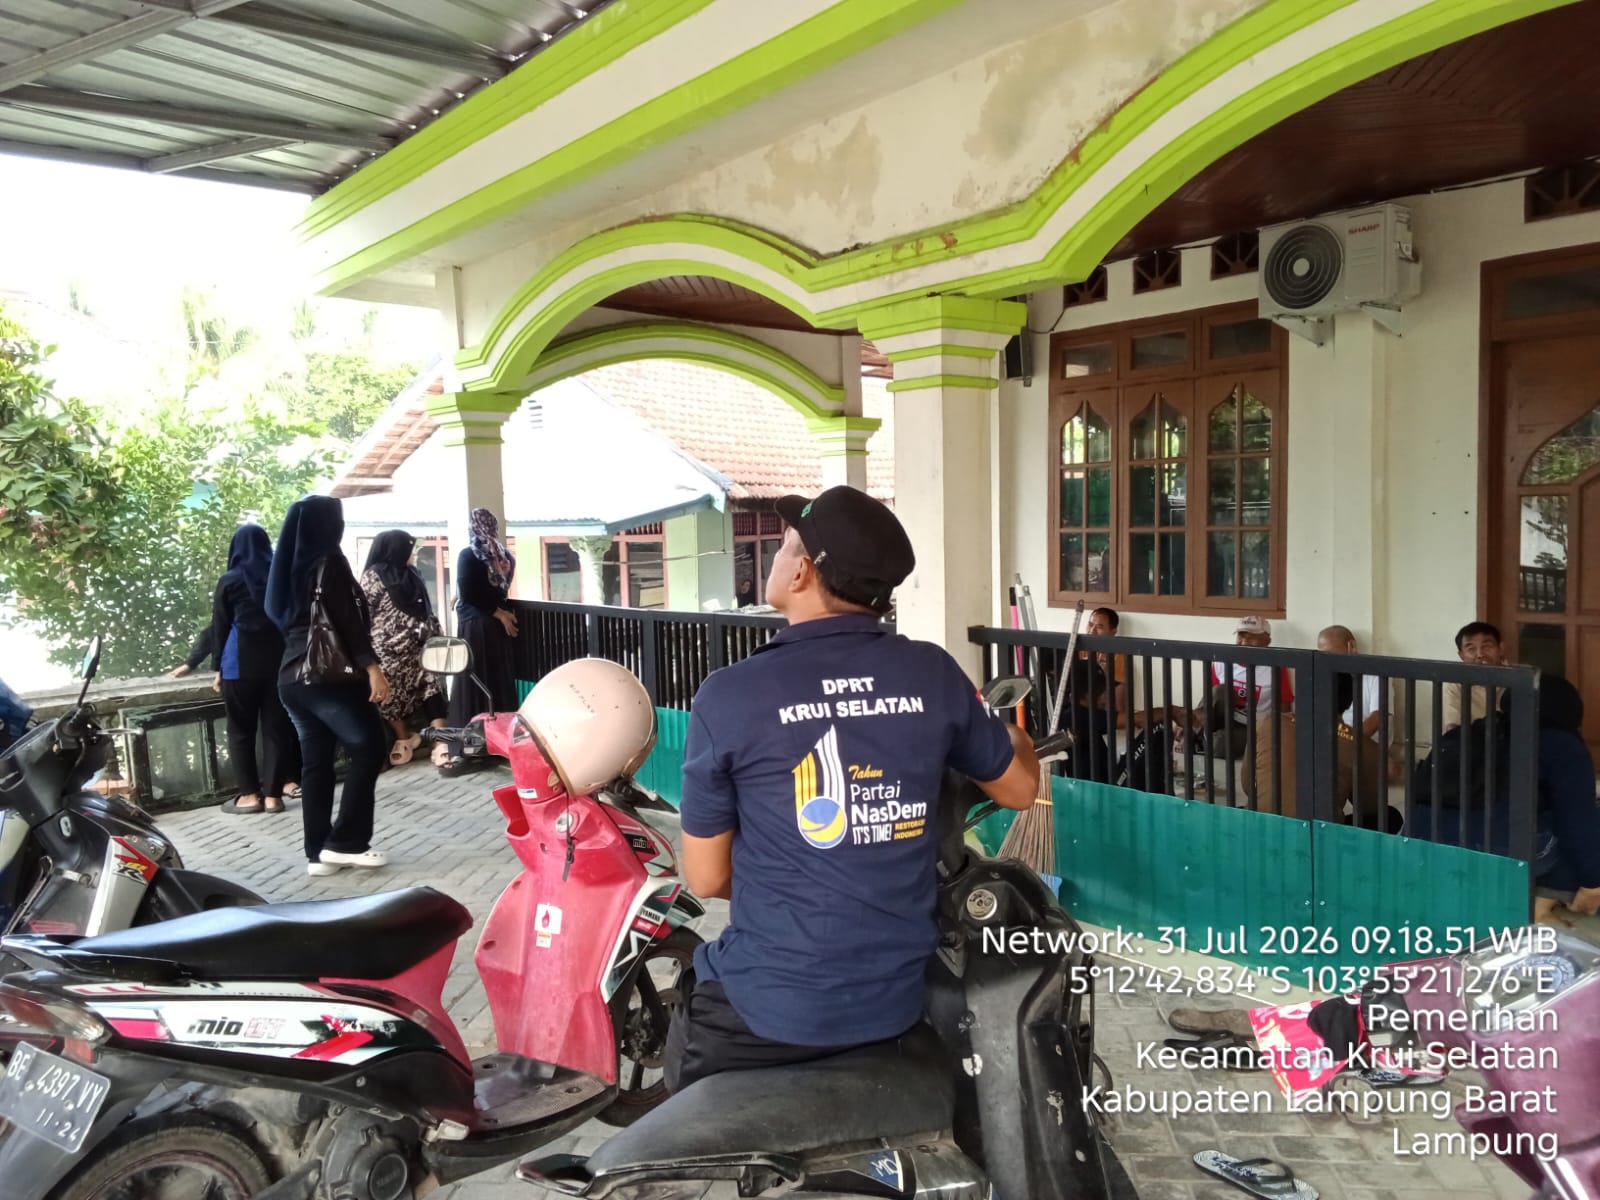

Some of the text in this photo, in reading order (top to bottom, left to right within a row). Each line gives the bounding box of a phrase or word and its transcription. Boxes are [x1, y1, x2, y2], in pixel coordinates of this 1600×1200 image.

[821, 676, 875, 696] DPRT
[778, 696, 925, 725] KRUI SELATAN
[848, 764, 884, 780] Tahun
[850, 780, 901, 802] Partai
[851, 800, 928, 825] NasDem
[852, 823, 893, 845] IT'S TIME!
[187, 1016, 245, 1036] mio
[7, 1050, 31, 1081] BE
[36, 1064, 81, 1101] 4397
